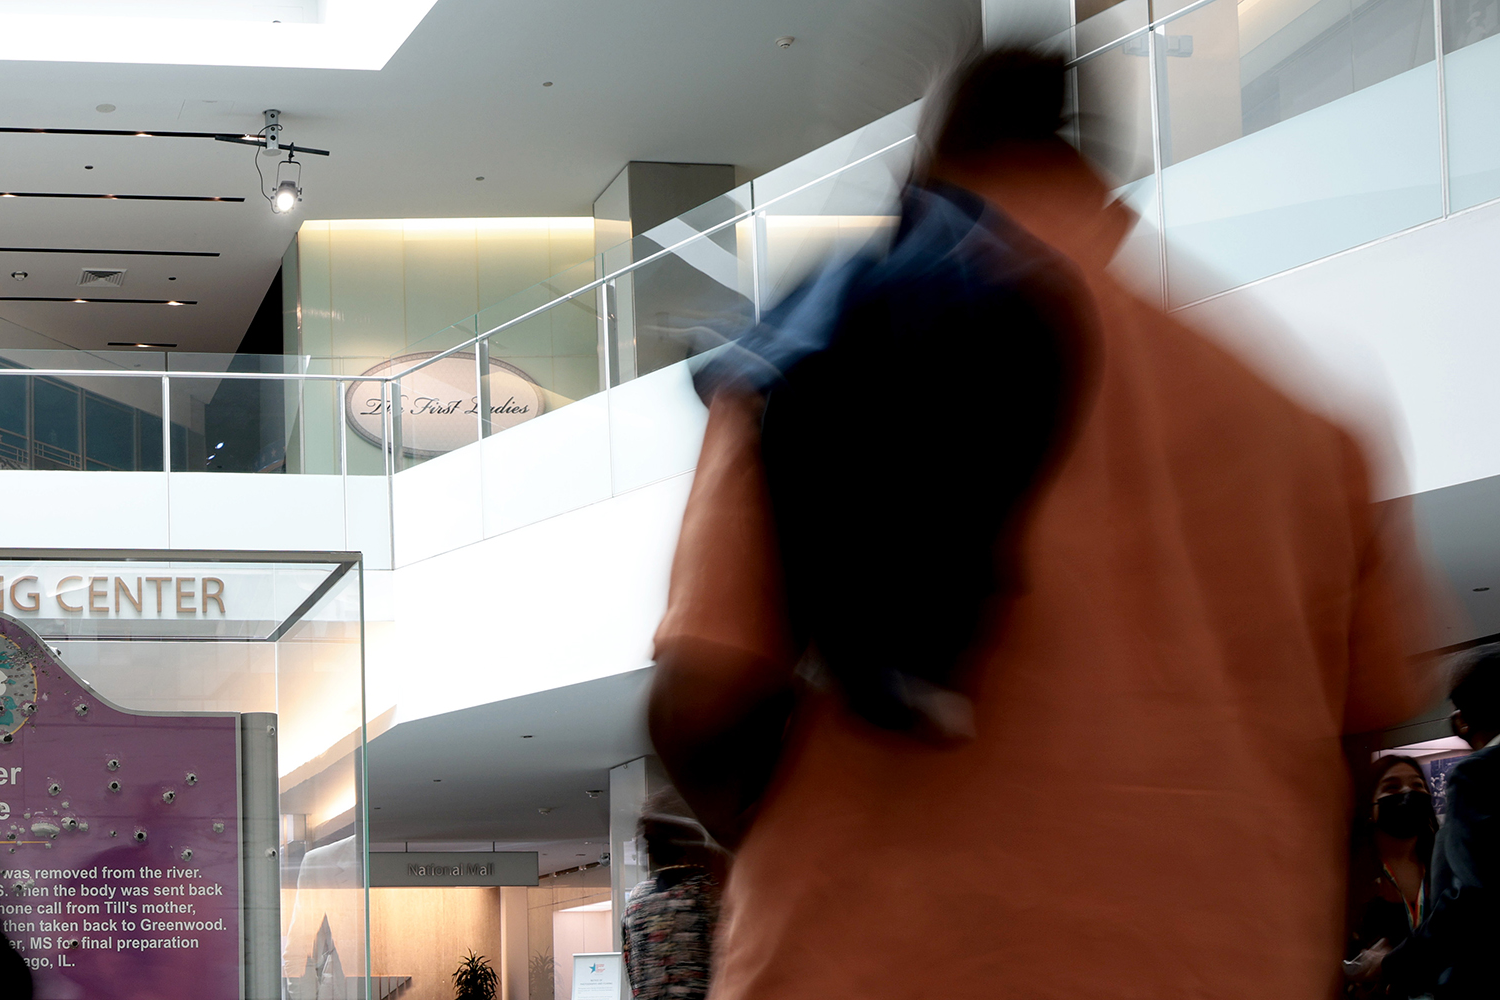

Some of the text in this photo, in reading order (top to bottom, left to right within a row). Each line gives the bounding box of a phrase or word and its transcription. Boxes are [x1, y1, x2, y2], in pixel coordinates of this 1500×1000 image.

[410, 397, 462, 415] First
[55, 574, 226, 613] CENTER
[1, 869, 30, 879] was
[34, 866, 98, 879] removed
[102, 866, 135, 879] from
[140, 866, 162, 879] the
[167, 866, 202, 878] river.
[407, 862, 495, 877] National Mall
[14, 884, 49, 897] hen
[53, 884, 76, 897] the
[80, 884, 117, 899] body
[121, 886, 150, 897] was
[153, 884, 185, 896] sent
[189, 883, 223, 896] back
[36, 901, 62, 914] call
[66, 901, 100, 914] from
[104, 901, 138, 914] Till's
[142, 901, 196, 915] mother,
[3, 919, 35, 932] then
[39, 919, 78, 932] taken
[83, 918, 118, 931] back
[121, 919, 136, 931] to
[140, 918, 227, 931] Greenwood.
[30, 937, 53, 949] MS
[56, 937, 79, 949] fo
[81, 936, 112, 949] final
[117, 936, 200, 952] preparation
[58, 954, 75, 967] IL.
